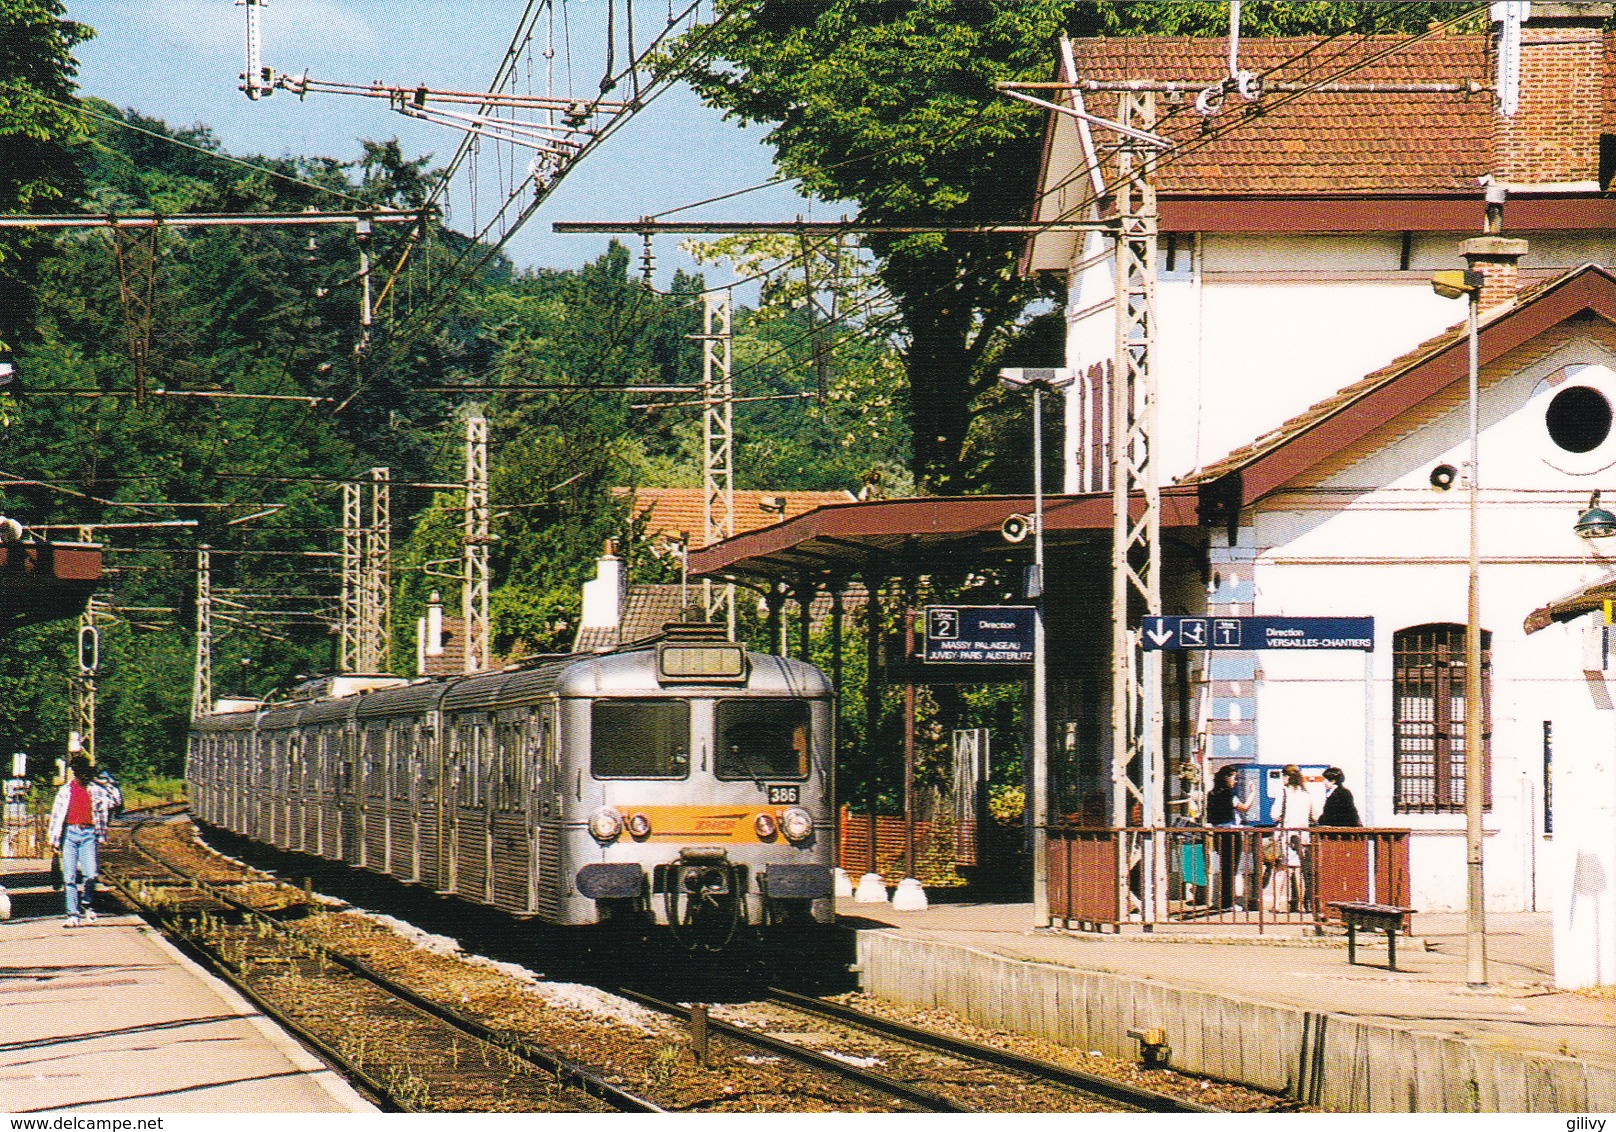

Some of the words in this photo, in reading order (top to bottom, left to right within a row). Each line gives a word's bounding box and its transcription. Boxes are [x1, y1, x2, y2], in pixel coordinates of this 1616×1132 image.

[938, 620, 950, 636] 2
[979, 620, 1016, 629] Direction
[1223, 629, 1230, 644] 1
[1266, 628, 1304, 637] Direction
[941, 641, 972, 650] MASSY
[974, 641, 1021, 650] PALAISEAU
[1266, 638, 1371, 647] VERSAILLES-CHANTIERS
[985, 651, 1033, 660] AUSTERLITZ
[771, 787, 797, 802] 386
